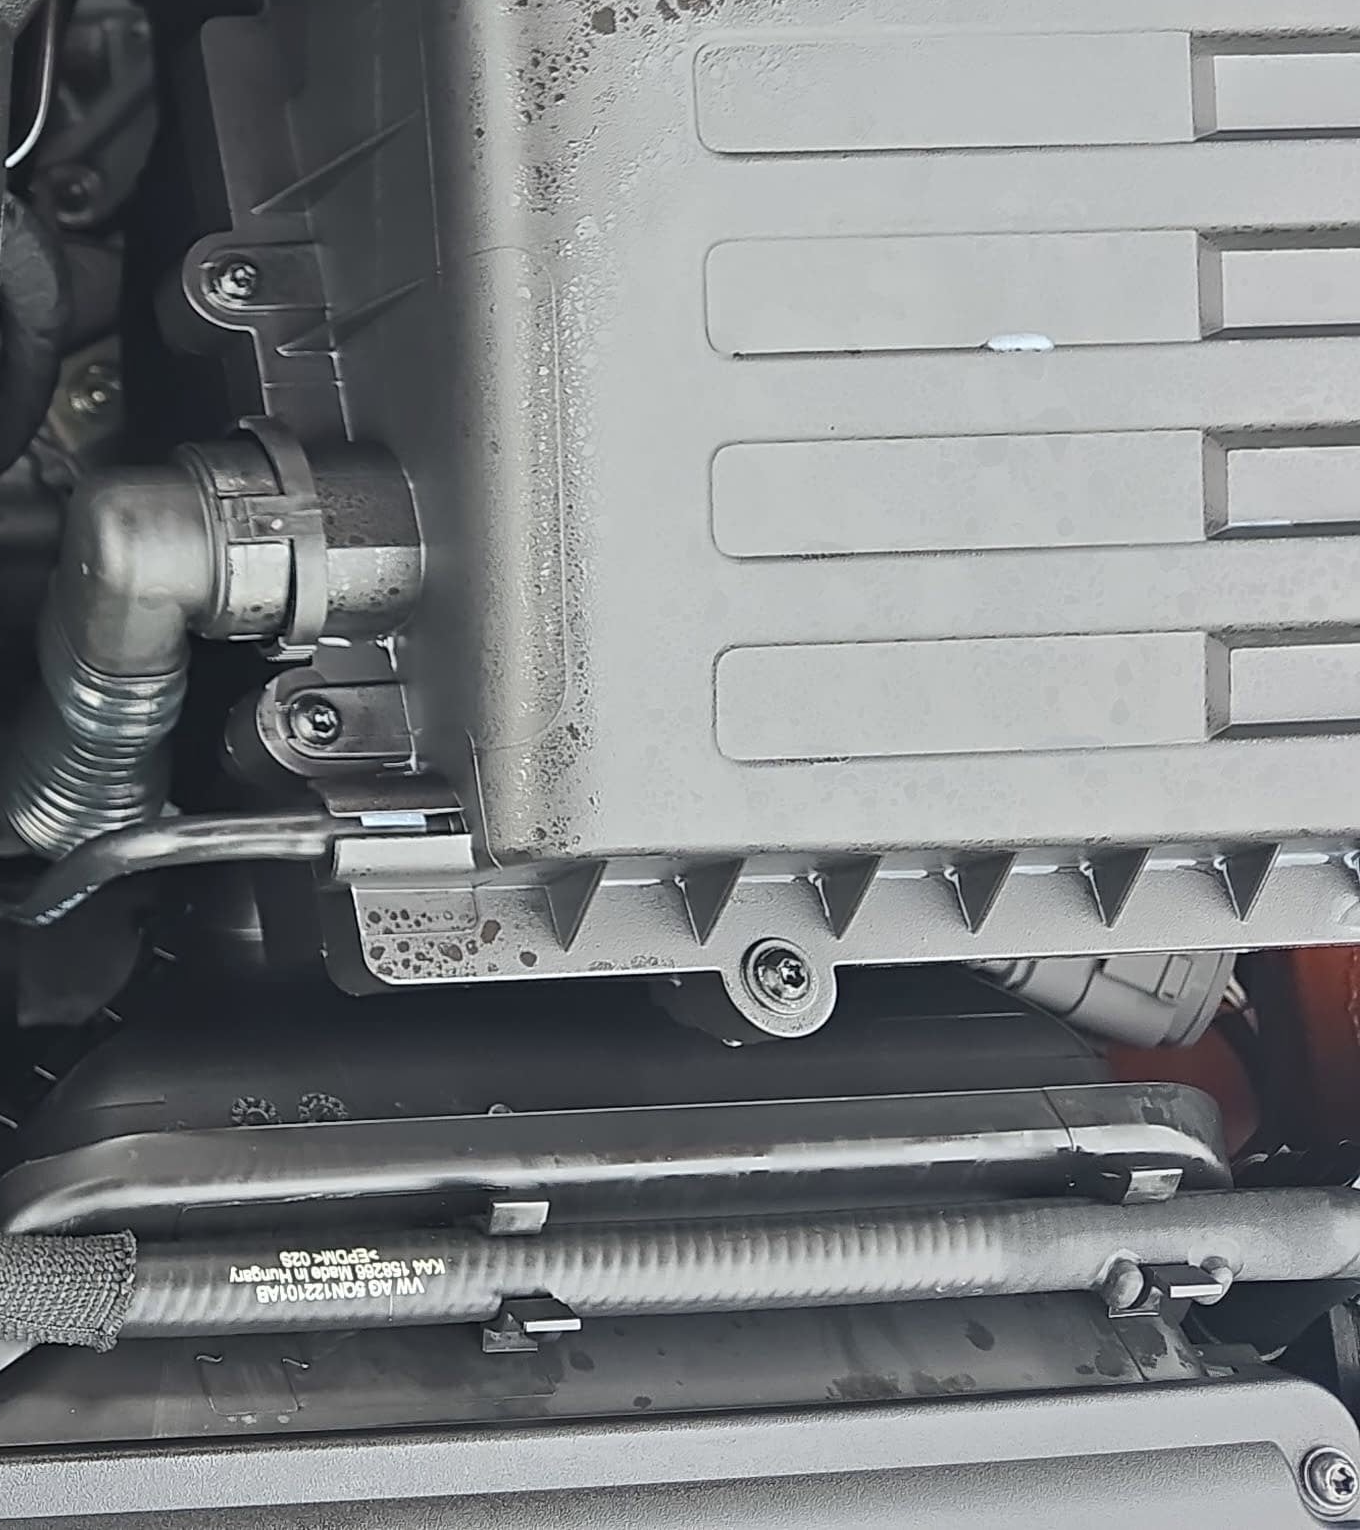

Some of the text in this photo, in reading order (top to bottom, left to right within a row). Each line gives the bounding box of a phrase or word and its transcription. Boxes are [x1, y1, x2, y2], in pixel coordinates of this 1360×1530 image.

[229, 1265, 292, 1285] Hungary
[311, 1265, 355, 1282] Made
[367, 1278, 393, 1297] AG
[395, 1277, 426, 1296] VW
